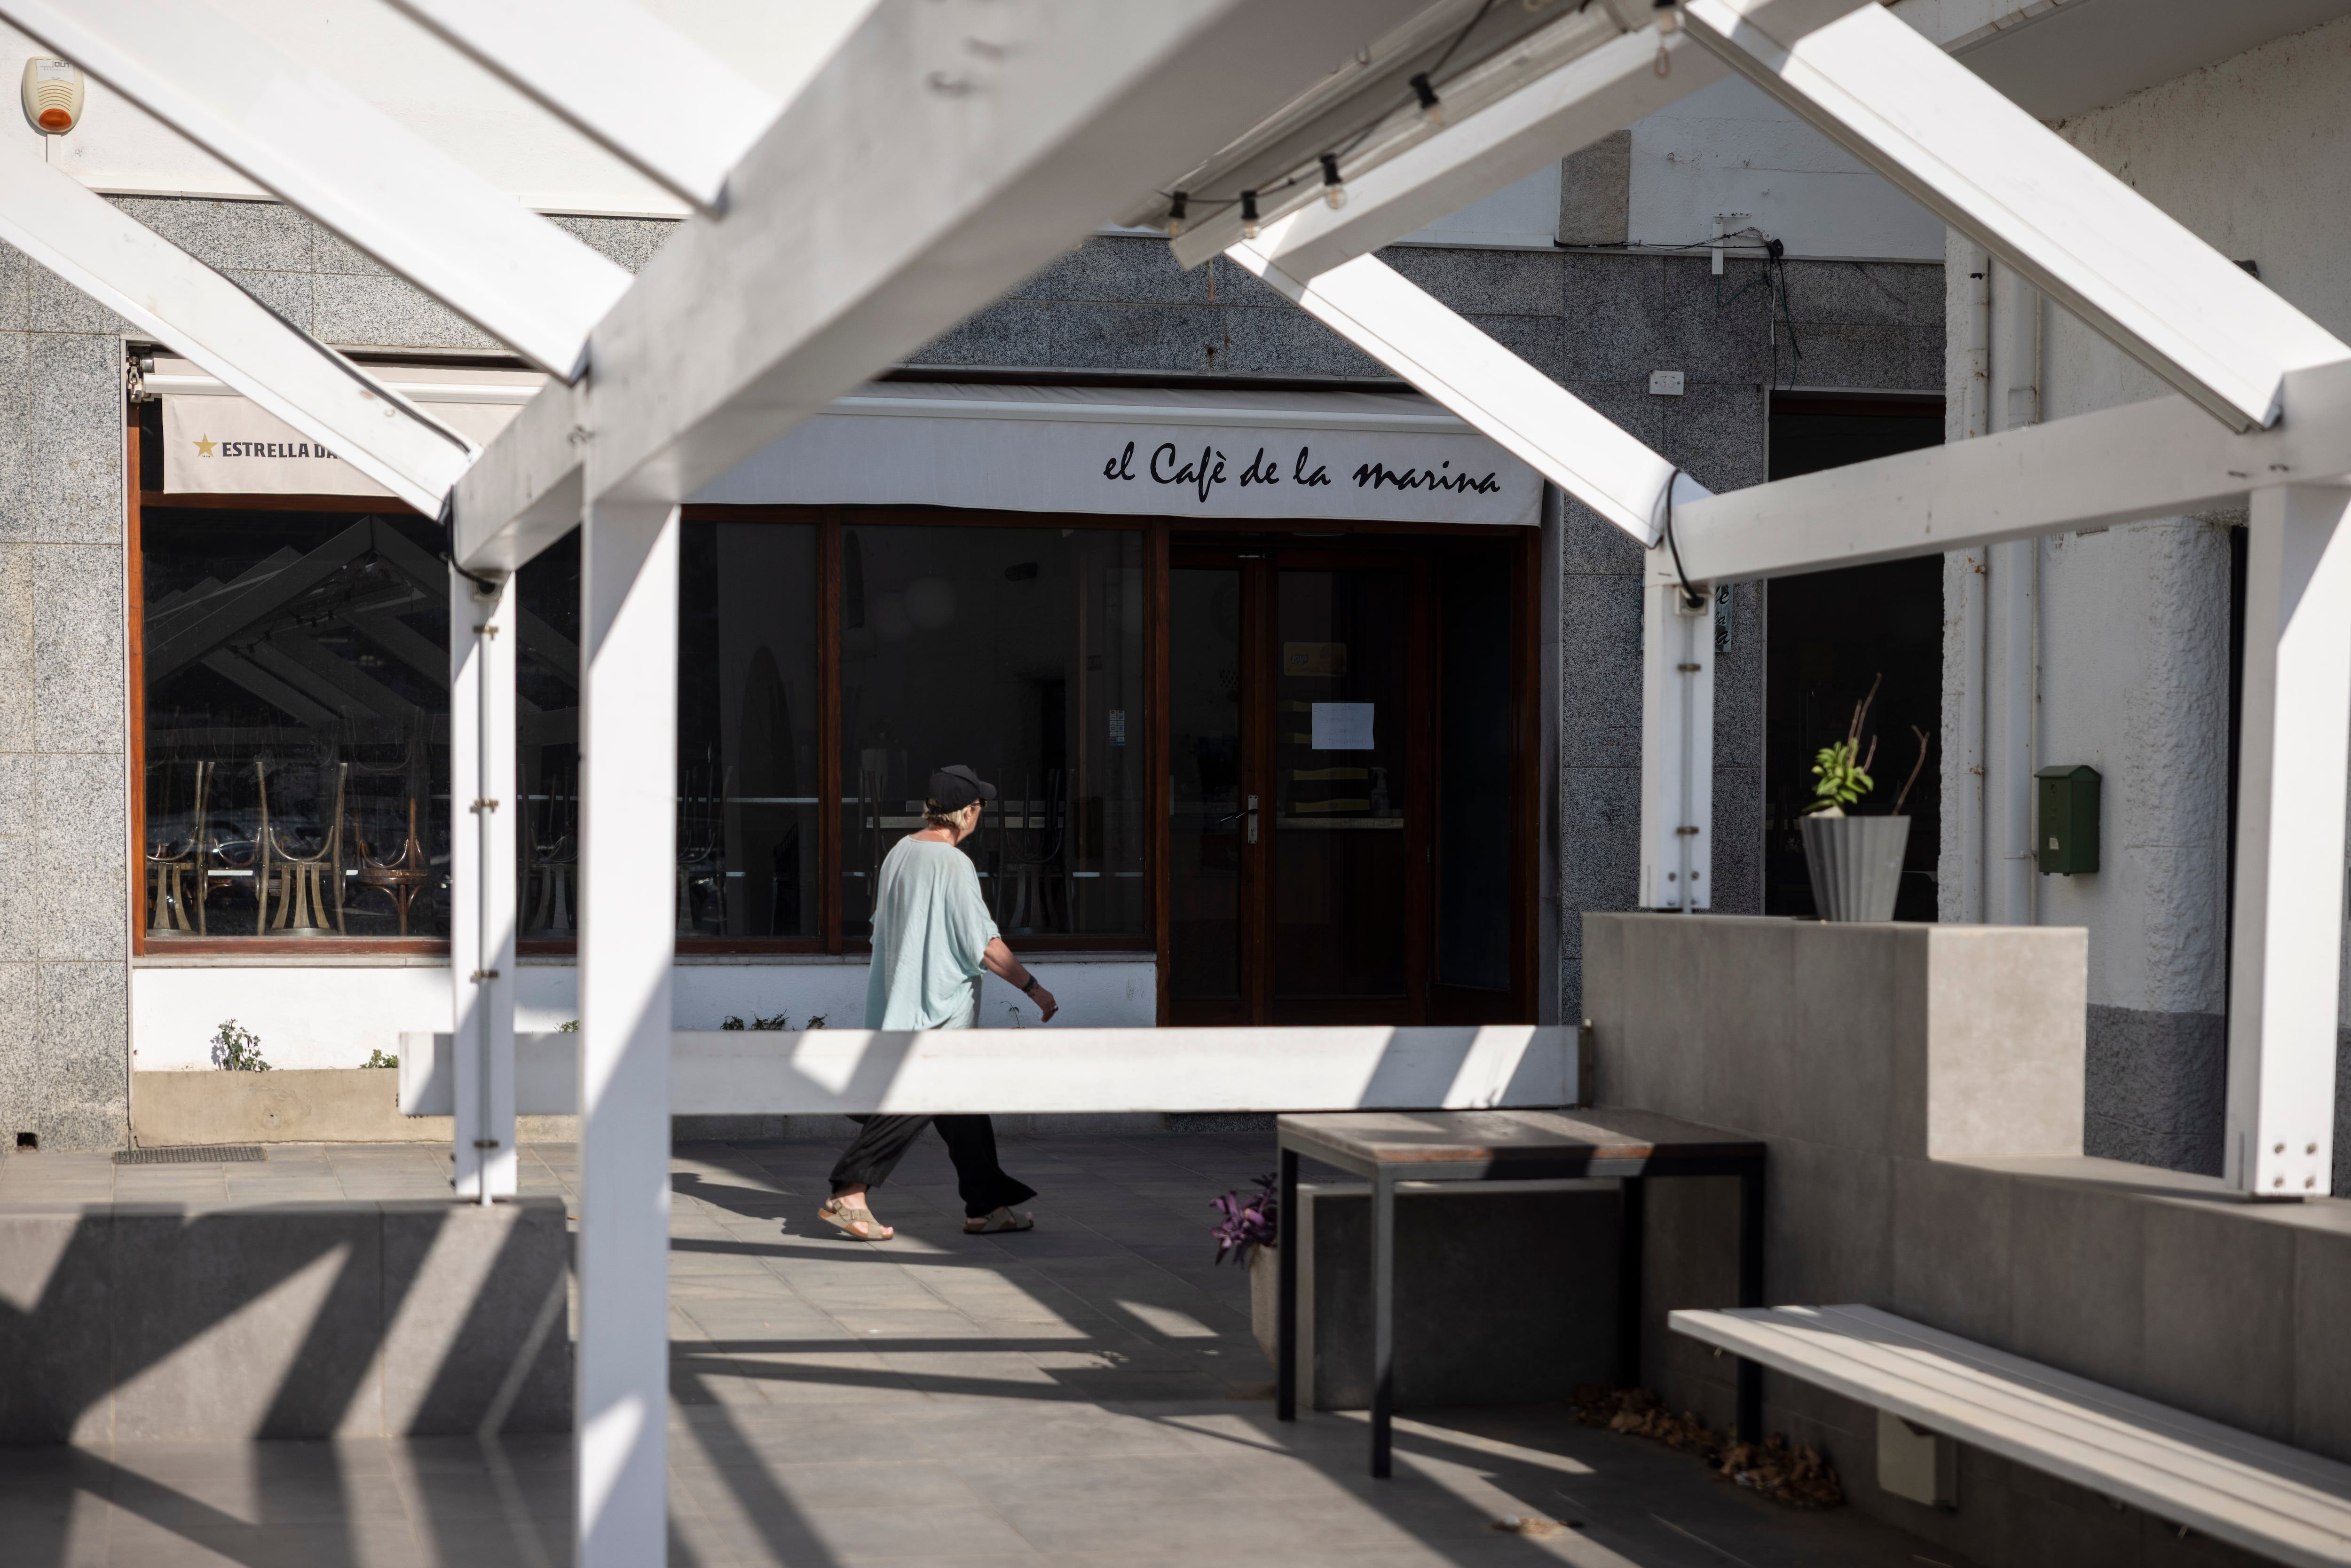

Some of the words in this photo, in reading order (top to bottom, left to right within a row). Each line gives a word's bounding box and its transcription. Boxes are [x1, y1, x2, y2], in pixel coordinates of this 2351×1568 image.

[1660, 376, 1675, 388] 35
[222, 442, 310, 458] ESTRELLA
[314, 443, 339, 459] DA
[1103, 441, 1136, 481] el
[1150, 442, 1227, 503] Cafè
[1239, 447, 1280, 487] de
[1293, 446, 1332, 487] la
[1352, 460, 1501, 494] marina
